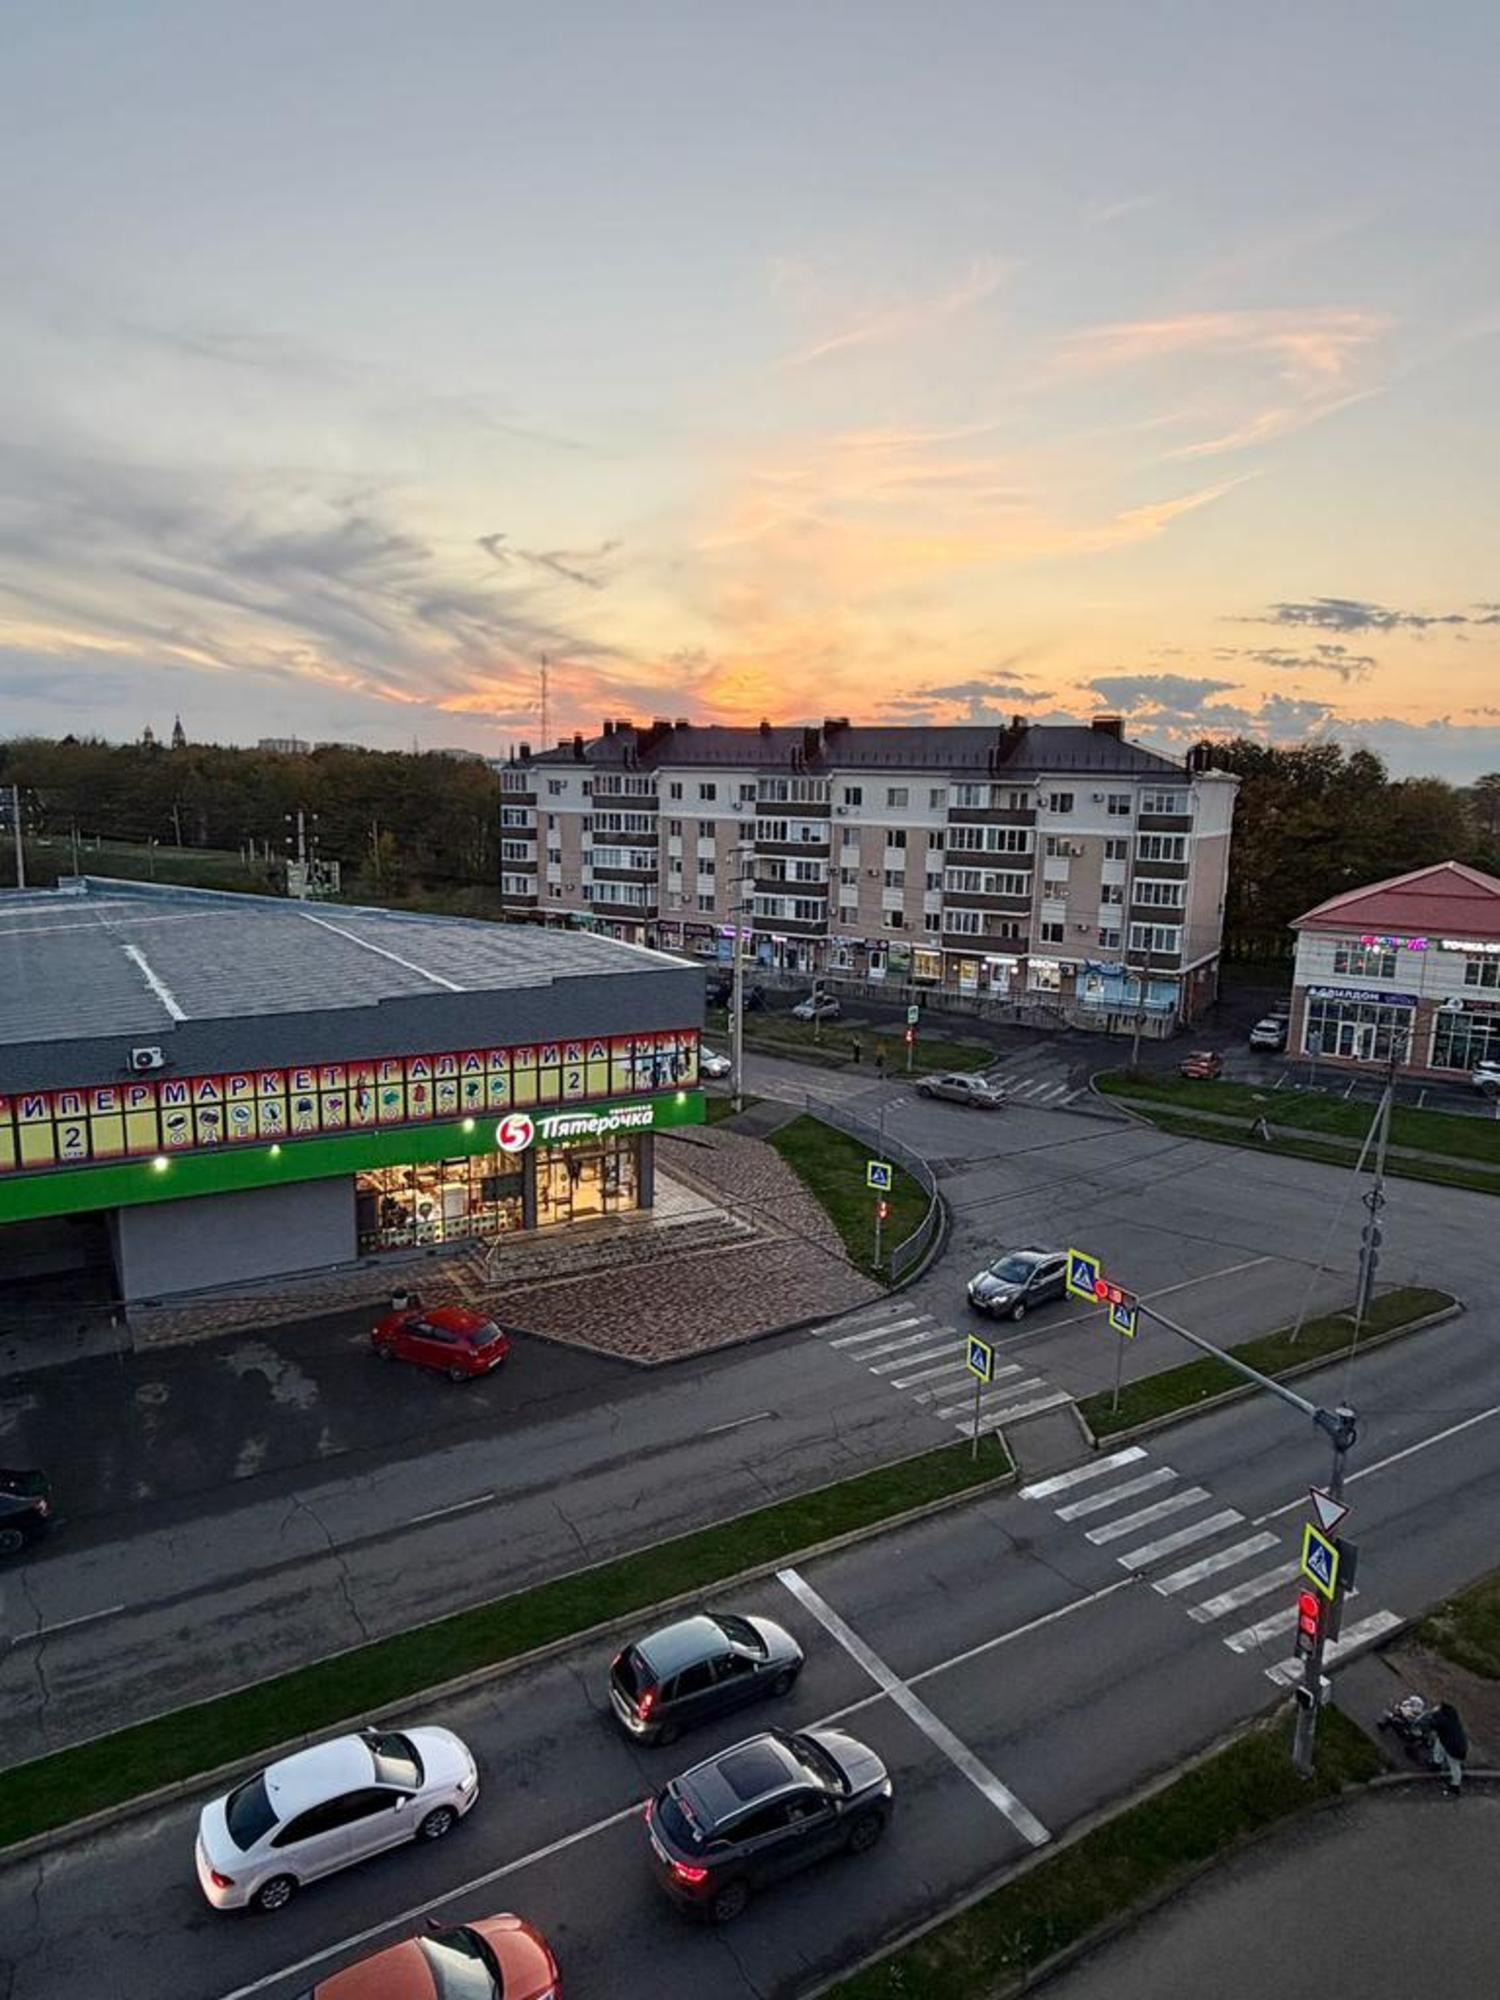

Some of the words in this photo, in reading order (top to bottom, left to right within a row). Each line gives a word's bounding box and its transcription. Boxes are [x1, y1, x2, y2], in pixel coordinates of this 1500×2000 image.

[0, 1066, 342, 1118] ИПЕРМАРКЕТ
[381, 1040, 605, 1081] ГАЛАКТИКА
[568, 1071, 580, 1091] 2
[65, 1126, 82, 1149] 2
[535, 1109, 655, 1140] Пятерочка
